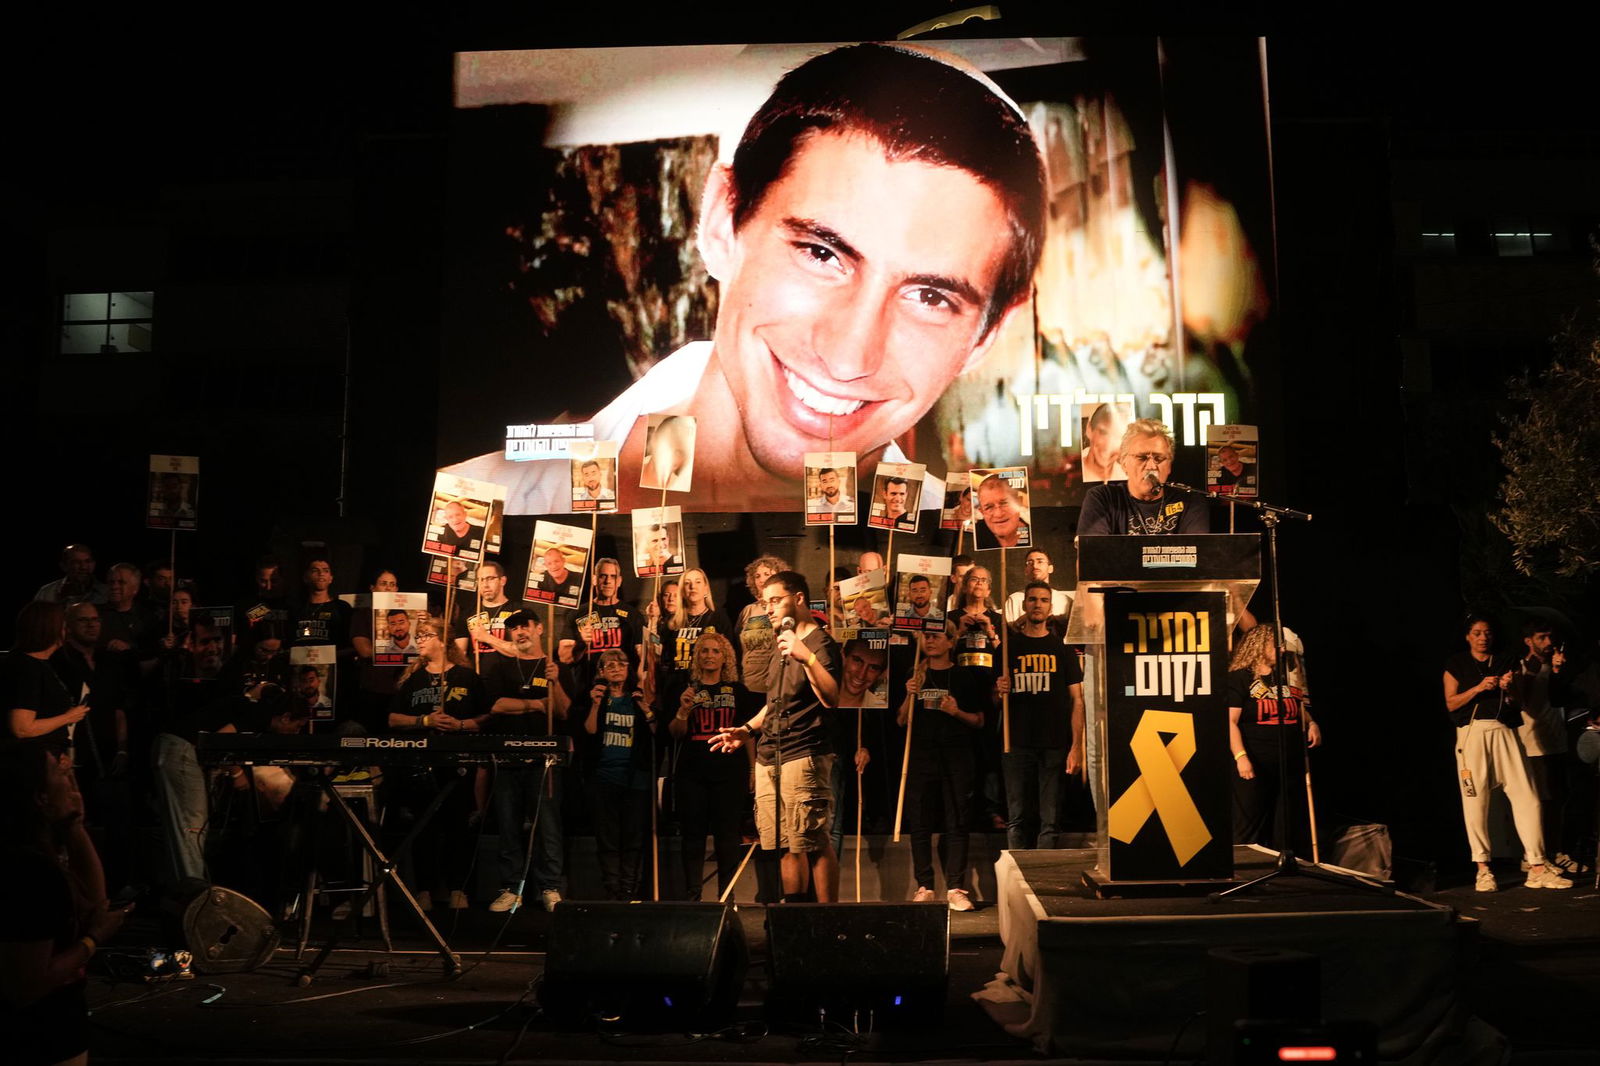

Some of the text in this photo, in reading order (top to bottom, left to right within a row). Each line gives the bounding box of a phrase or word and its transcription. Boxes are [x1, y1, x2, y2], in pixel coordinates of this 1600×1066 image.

[1017, 388, 1225, 456] הדר גדין
[1123, 611, 1210, 654] נחזיר.
[1013, 653, 1057, 673] נחזיר.
[1012, 672, 1050, 695] נקום.
[1124, 654, 1211, 702] נקום.
[366, 737, 428, 748] Roland
[504, 740, 558, 748] RD-2000
